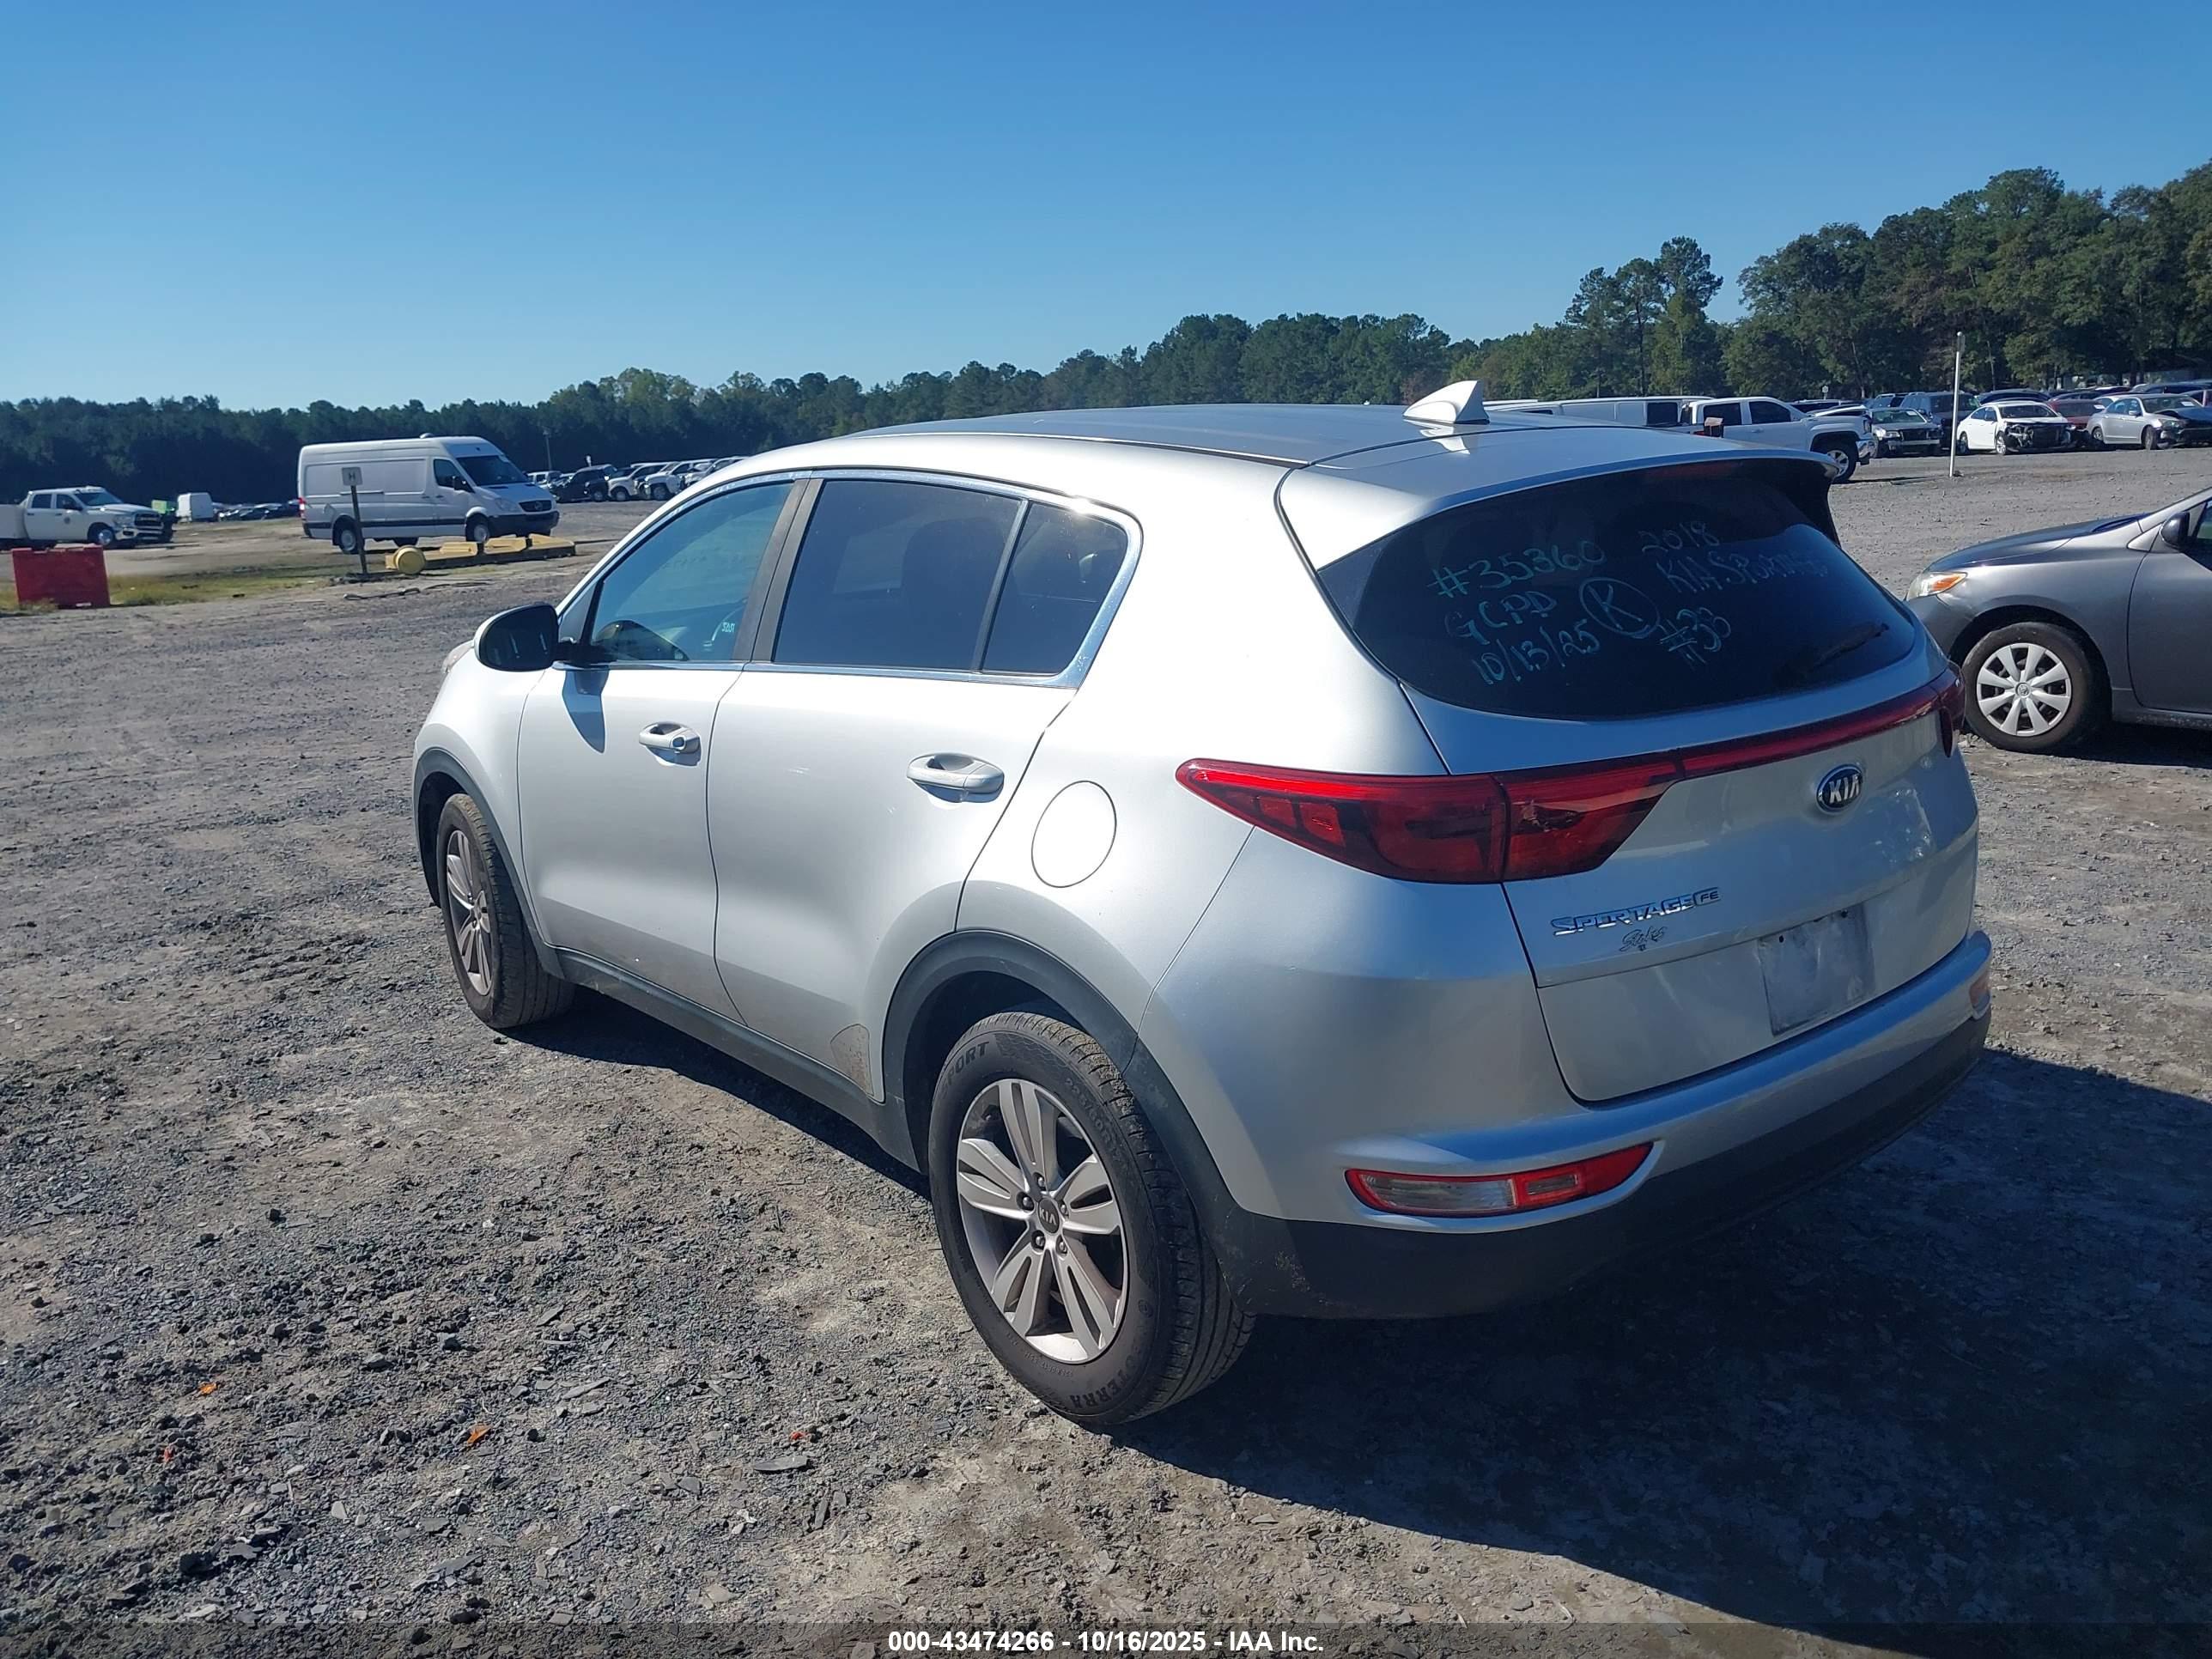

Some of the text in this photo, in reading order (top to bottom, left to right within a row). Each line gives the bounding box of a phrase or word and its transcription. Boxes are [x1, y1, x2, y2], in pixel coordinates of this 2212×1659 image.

[1638, 521, 1720, 554] 2018
[1426, 540, 1604, 599] #35360
[1656, 550, 1828, 593] KIA SPORT
[1444, 591, 1558, 645] GCPD
[1588, 582, 1644, 631] K
[1471, 618, 1601, 685] 10/13/25
[1829, 774, 1860, 804] KIA
[1551, 894, 1695, 935] SPORTAGE
[1039, 1206, 1057, 1225] KIA
